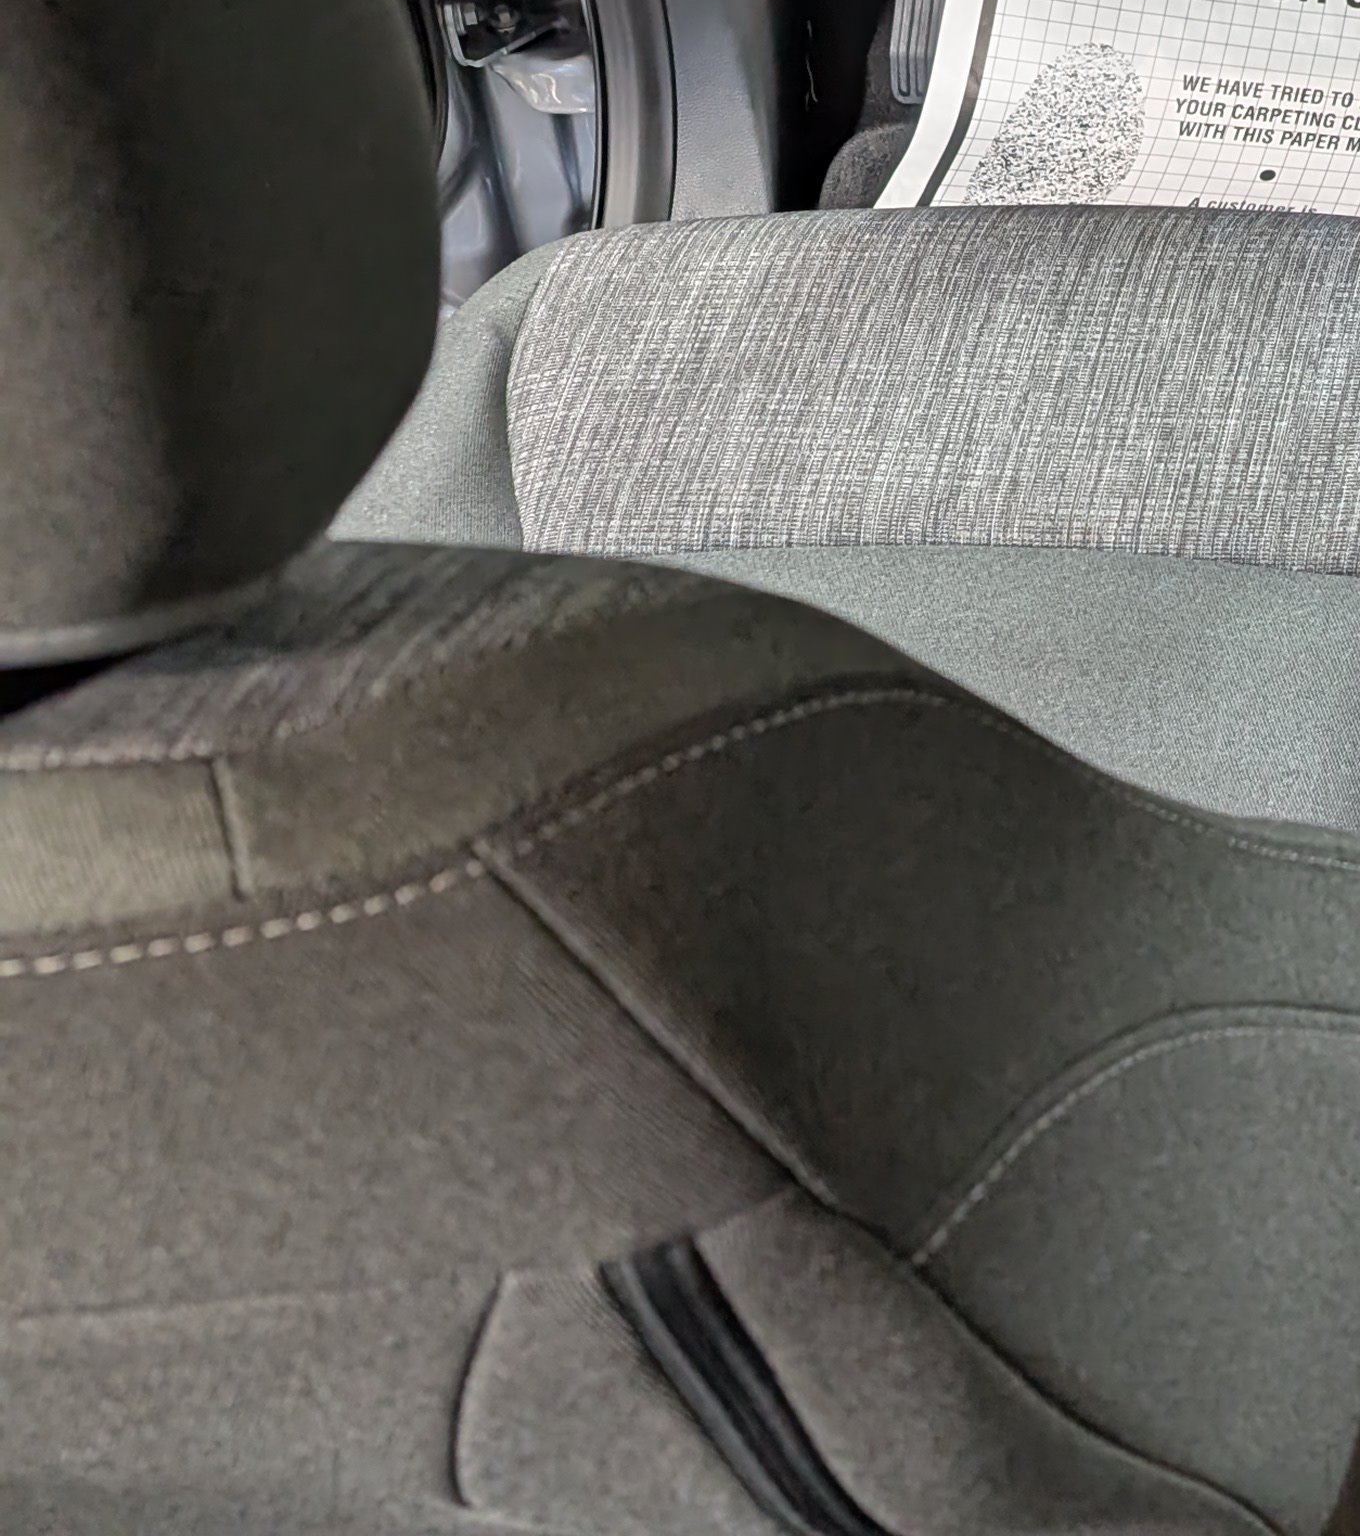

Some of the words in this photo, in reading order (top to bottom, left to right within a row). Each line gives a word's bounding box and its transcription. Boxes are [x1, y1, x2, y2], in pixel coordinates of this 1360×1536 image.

[1182, 74, 1211, 93] WE
[1215, 78, 1264, 99] HAVE
[1271, 84, 1324, 105] TRIED
[1331, 91, 1353, 108] TO
[1175, 98, 1226, 117] YOUR
[1231, 104, 1336, 128] CARPETING
[1178, 120, 1227, 140] WITH
[1233, 126, 1273, 144] THIS
[1279, 130, 1340, 151] PAPER
[1188, 197, 1200, 208] A
